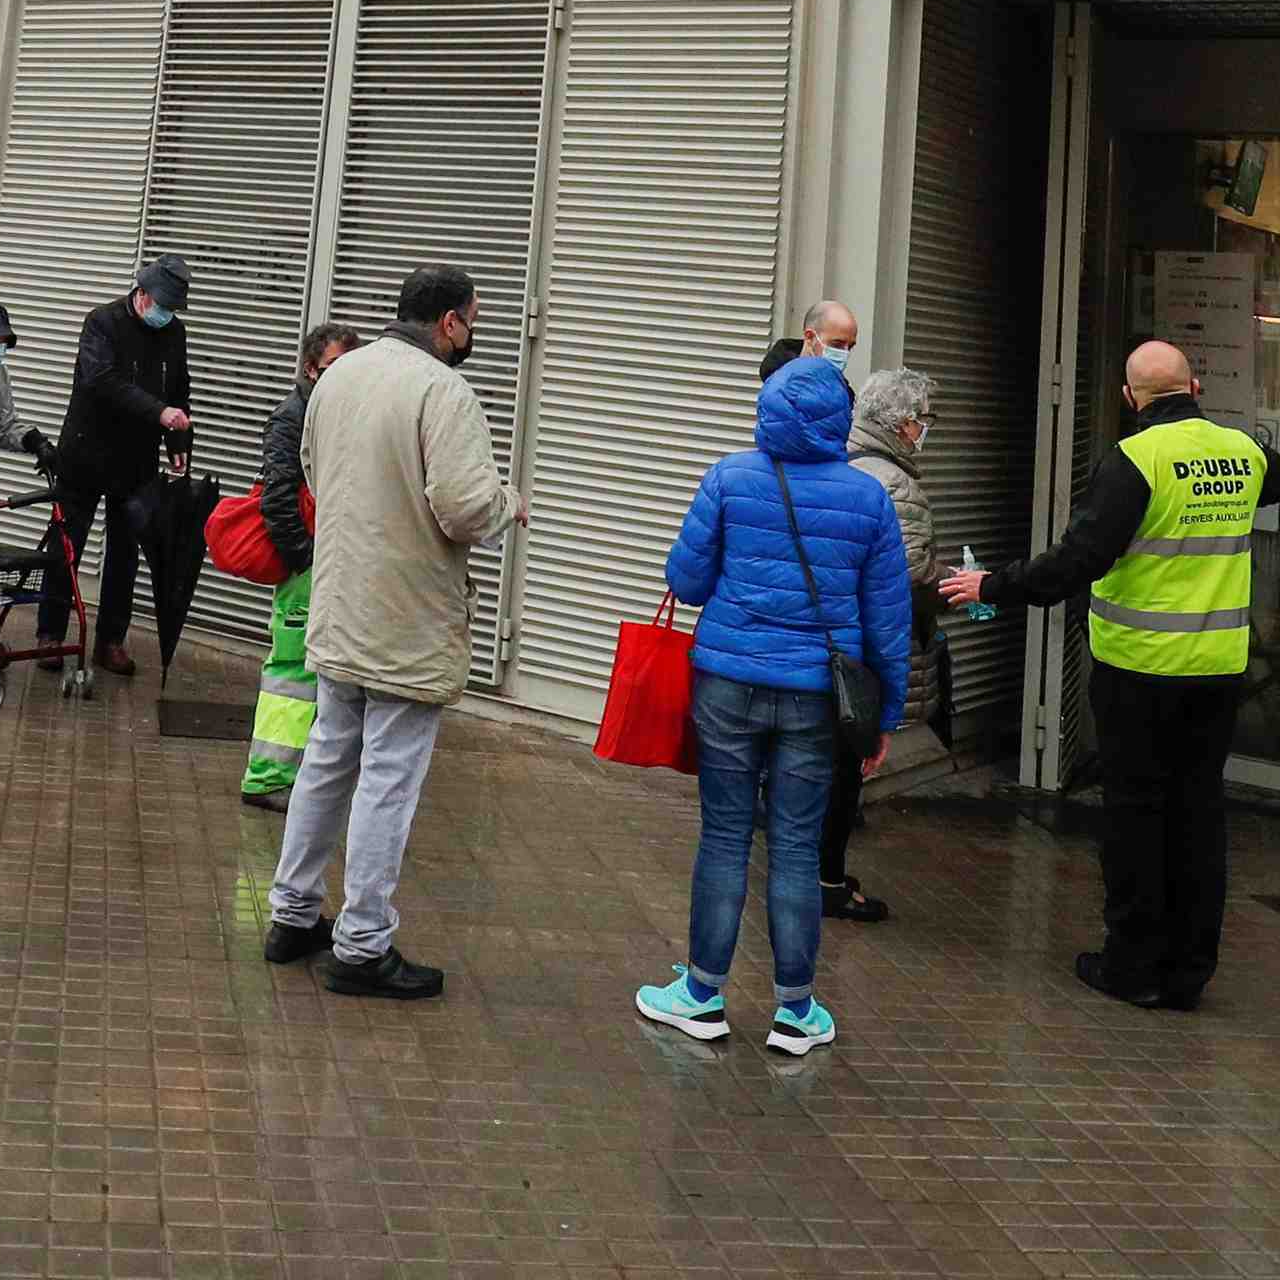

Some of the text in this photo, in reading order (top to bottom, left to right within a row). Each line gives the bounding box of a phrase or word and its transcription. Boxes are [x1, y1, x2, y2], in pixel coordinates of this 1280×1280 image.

[1173, 458, 1252, 480] DOUBLE
[1192, 480, 1244, 496] GROUP
[1179, 513, 1214, 525] SERVEIS
